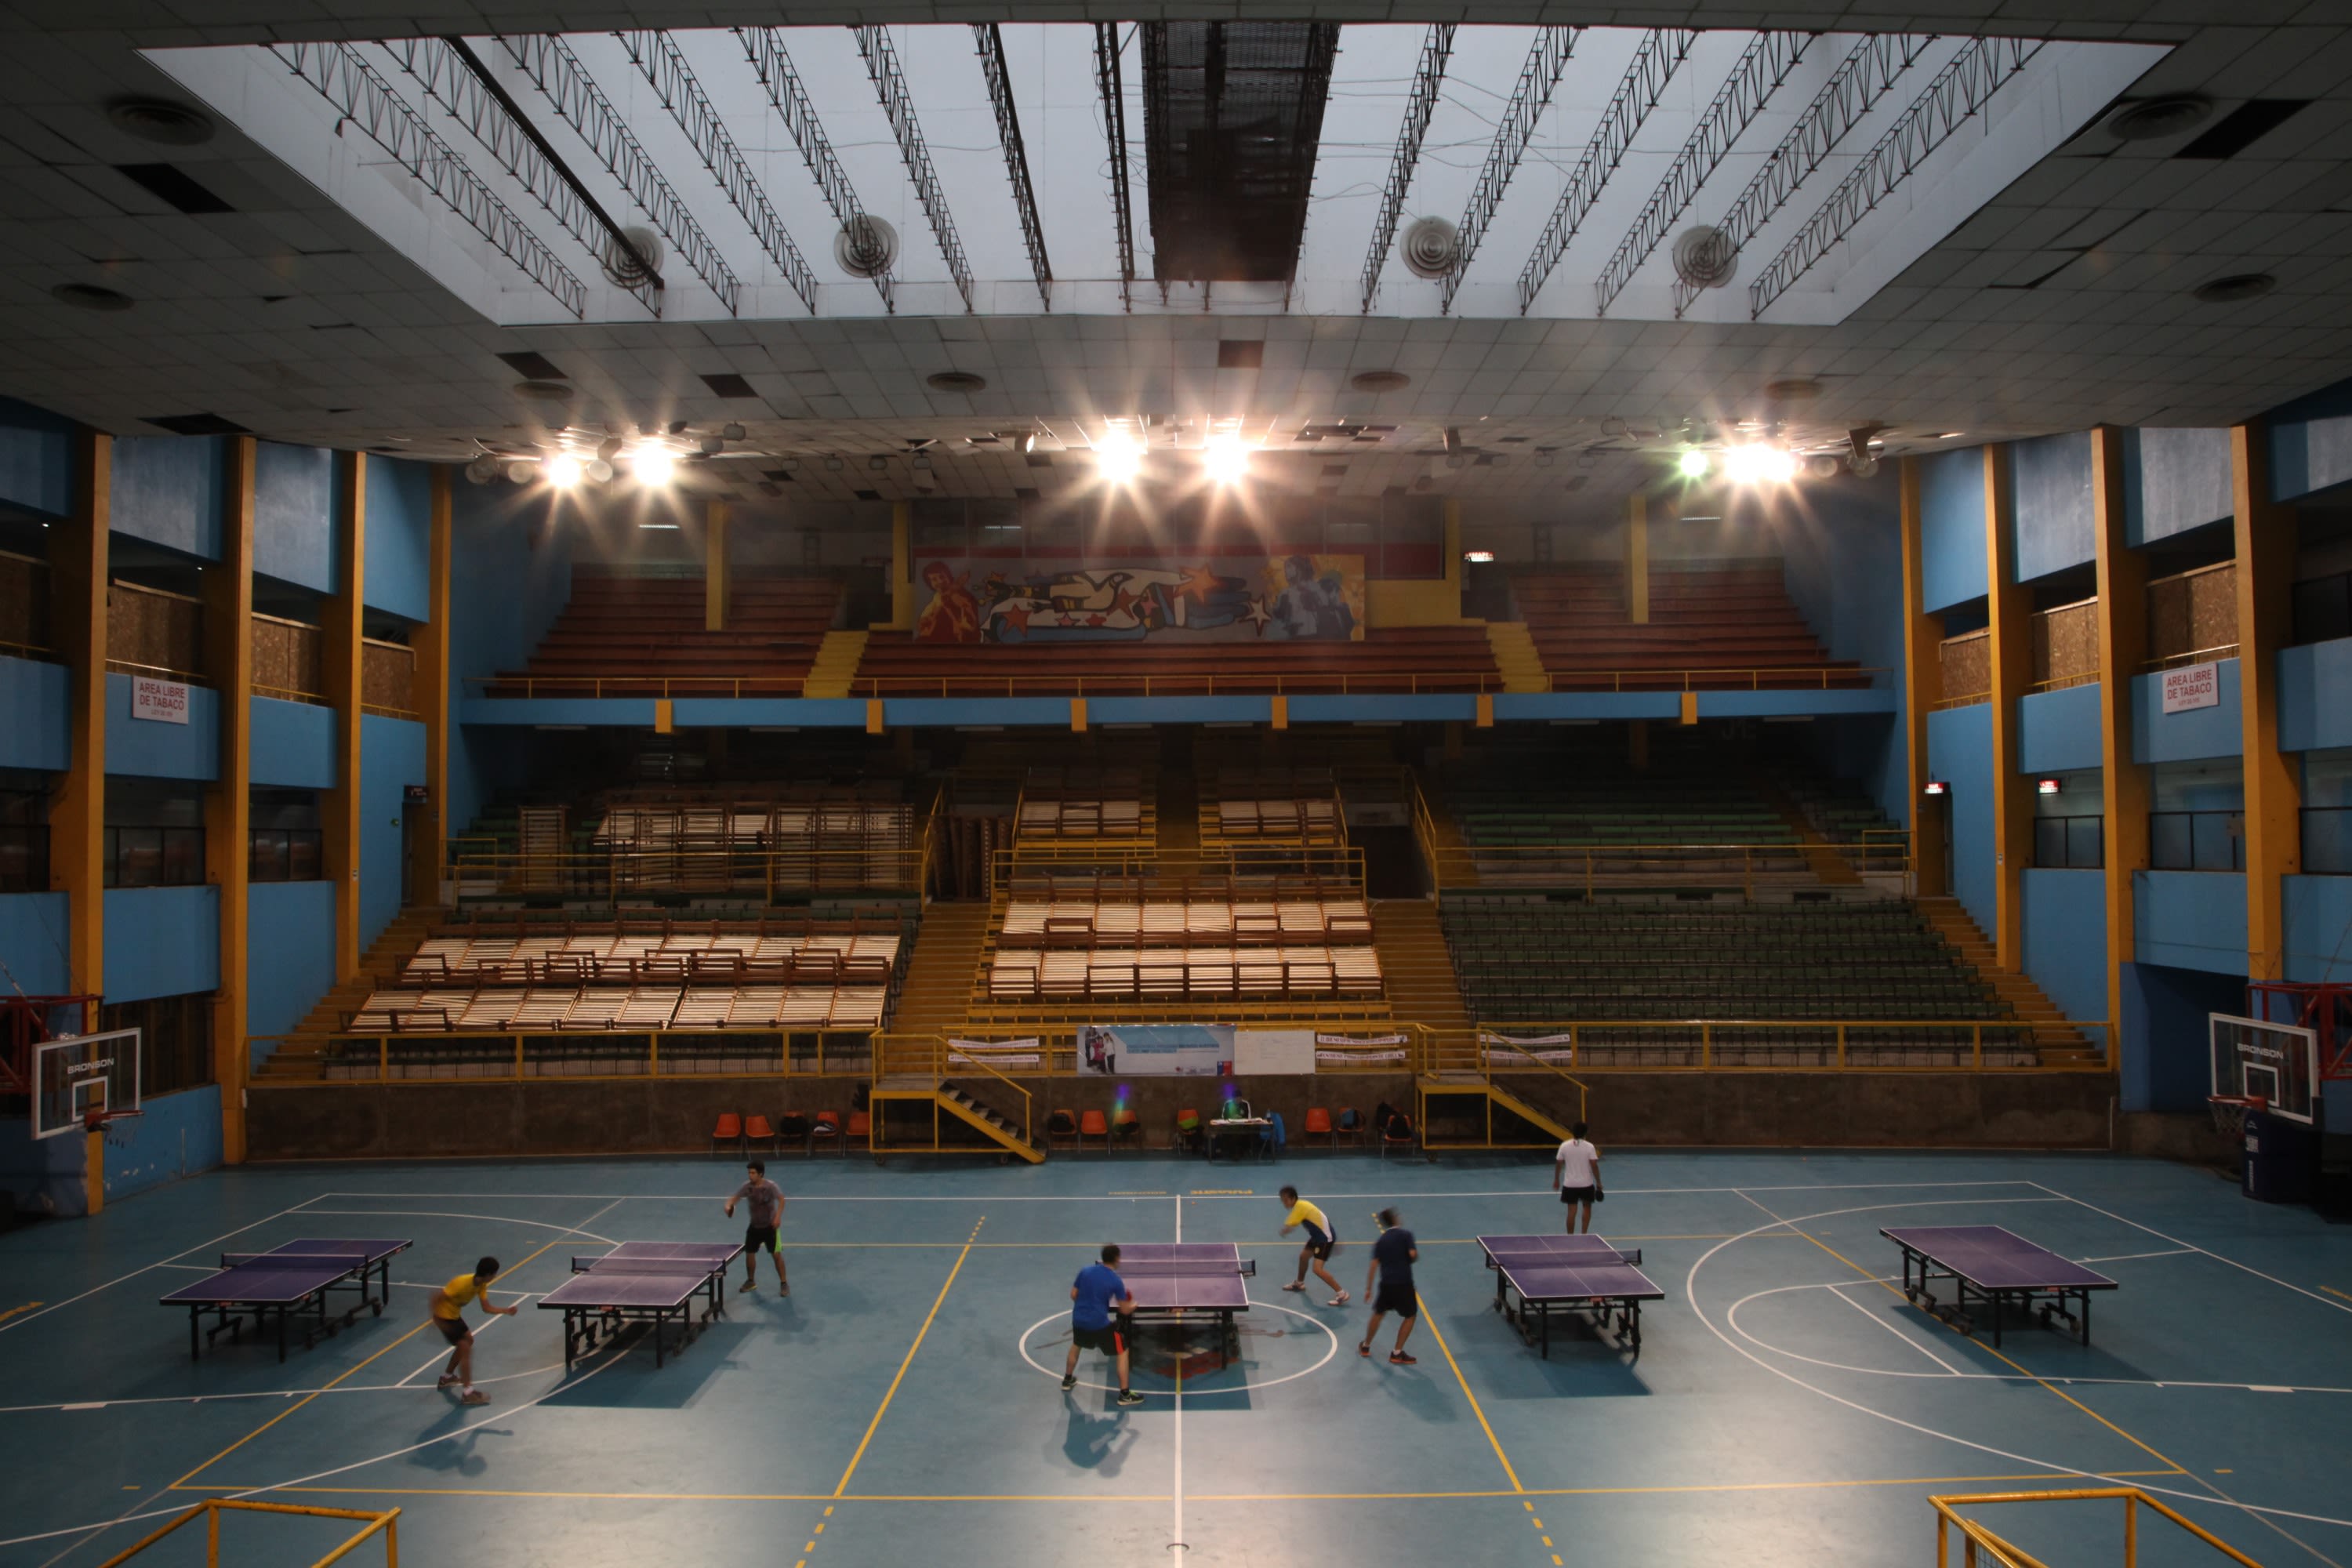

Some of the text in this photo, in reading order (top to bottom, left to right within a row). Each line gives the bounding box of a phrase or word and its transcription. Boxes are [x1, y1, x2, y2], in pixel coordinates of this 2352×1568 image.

[2167, 670, 2212, 688] AREA LIBRE
[140, 682, 185, 699] AREA LIBRE
[2167, 682, 2212, 700] DE TABACO
[140, 695, 184, 710] DE TABACO
[2237, 1042, 2283, 1060] BRONSON
[67, 1058, 114, 1074] BRONSON
